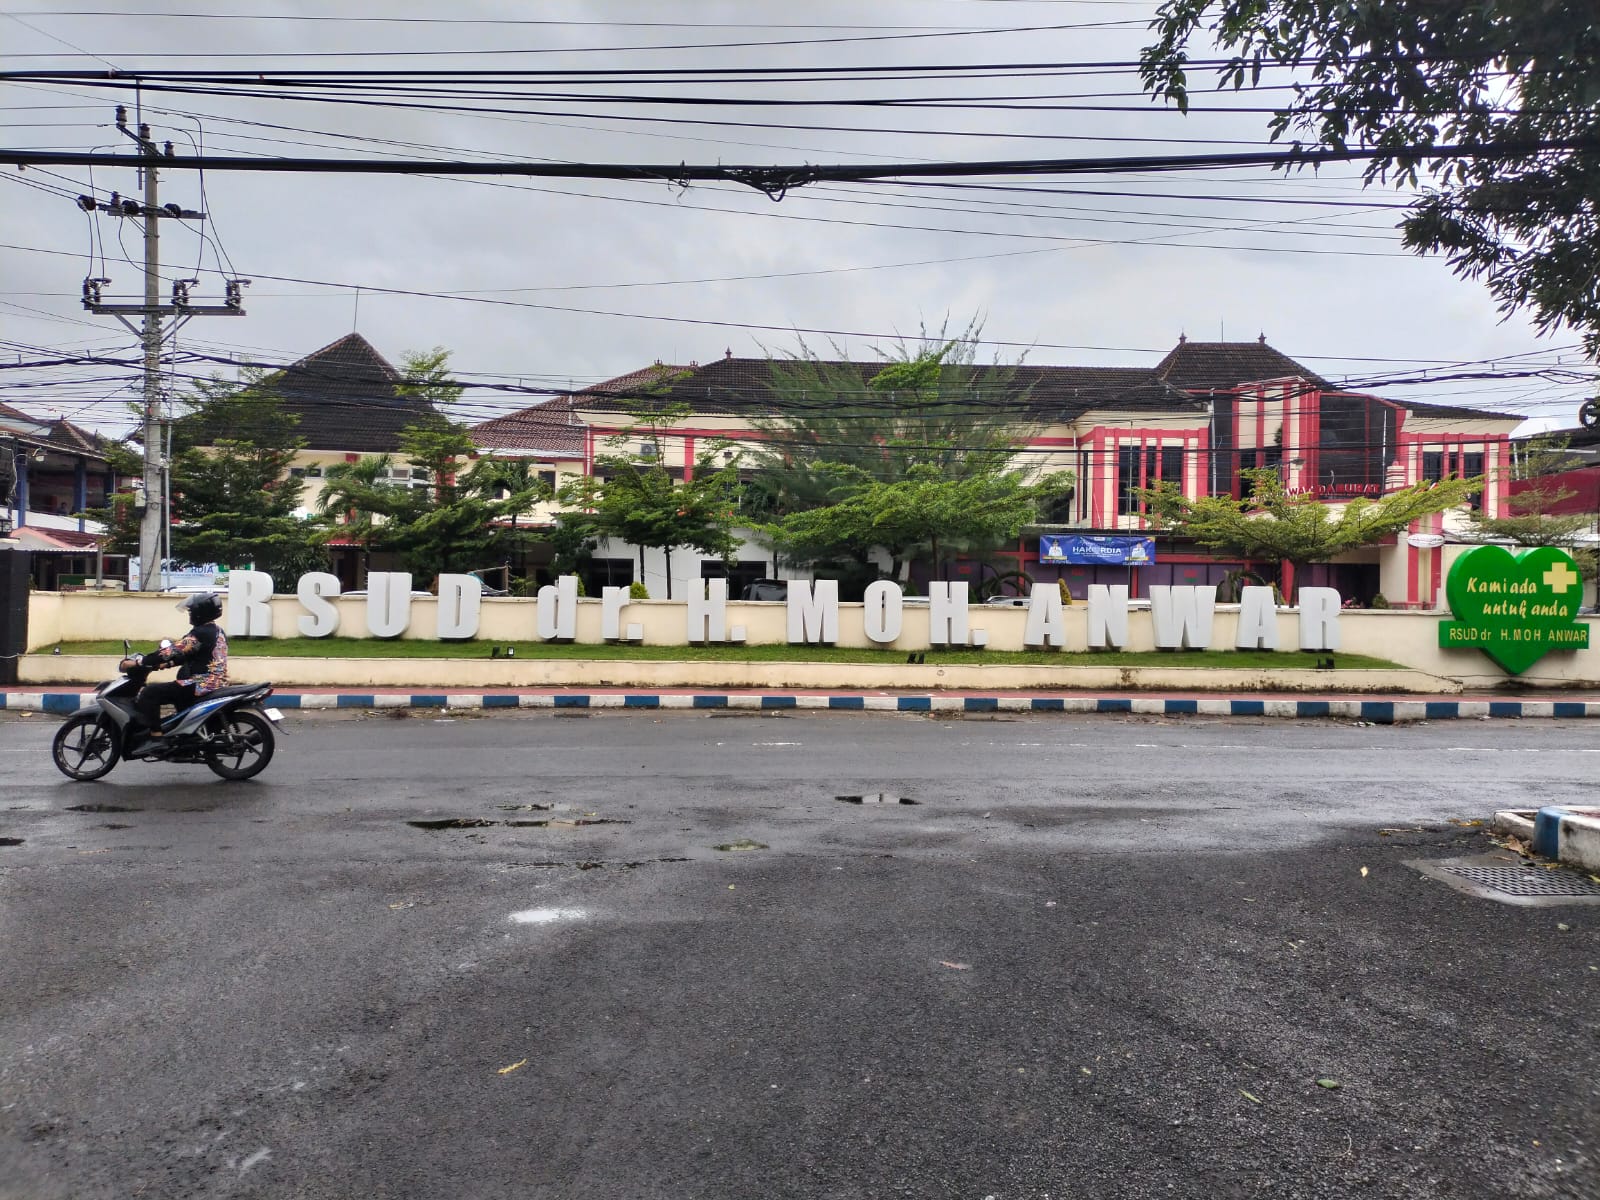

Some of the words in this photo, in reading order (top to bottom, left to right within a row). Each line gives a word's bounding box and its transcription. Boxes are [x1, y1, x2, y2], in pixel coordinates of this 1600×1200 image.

[1466, 576, 1507, 593] Kami
[1509, 577, 1537, 594] ada
[228, 569, 482, 640] RSUD
[537, 575, 643, 640] dr.
[687, 577, 746, 642] H.
[787, 579, 989, 646] MOH.
[1023, 582, 1342, 650] ANWAR
[1482, 600, 1527, 619] untuk
[1531, 600, 1568, 617] anda
[1449, 627, 1478, 641] RSUD
[1480, 628, 1492, 641] dr
[1547, 629, 1587, 642] ANWAR
